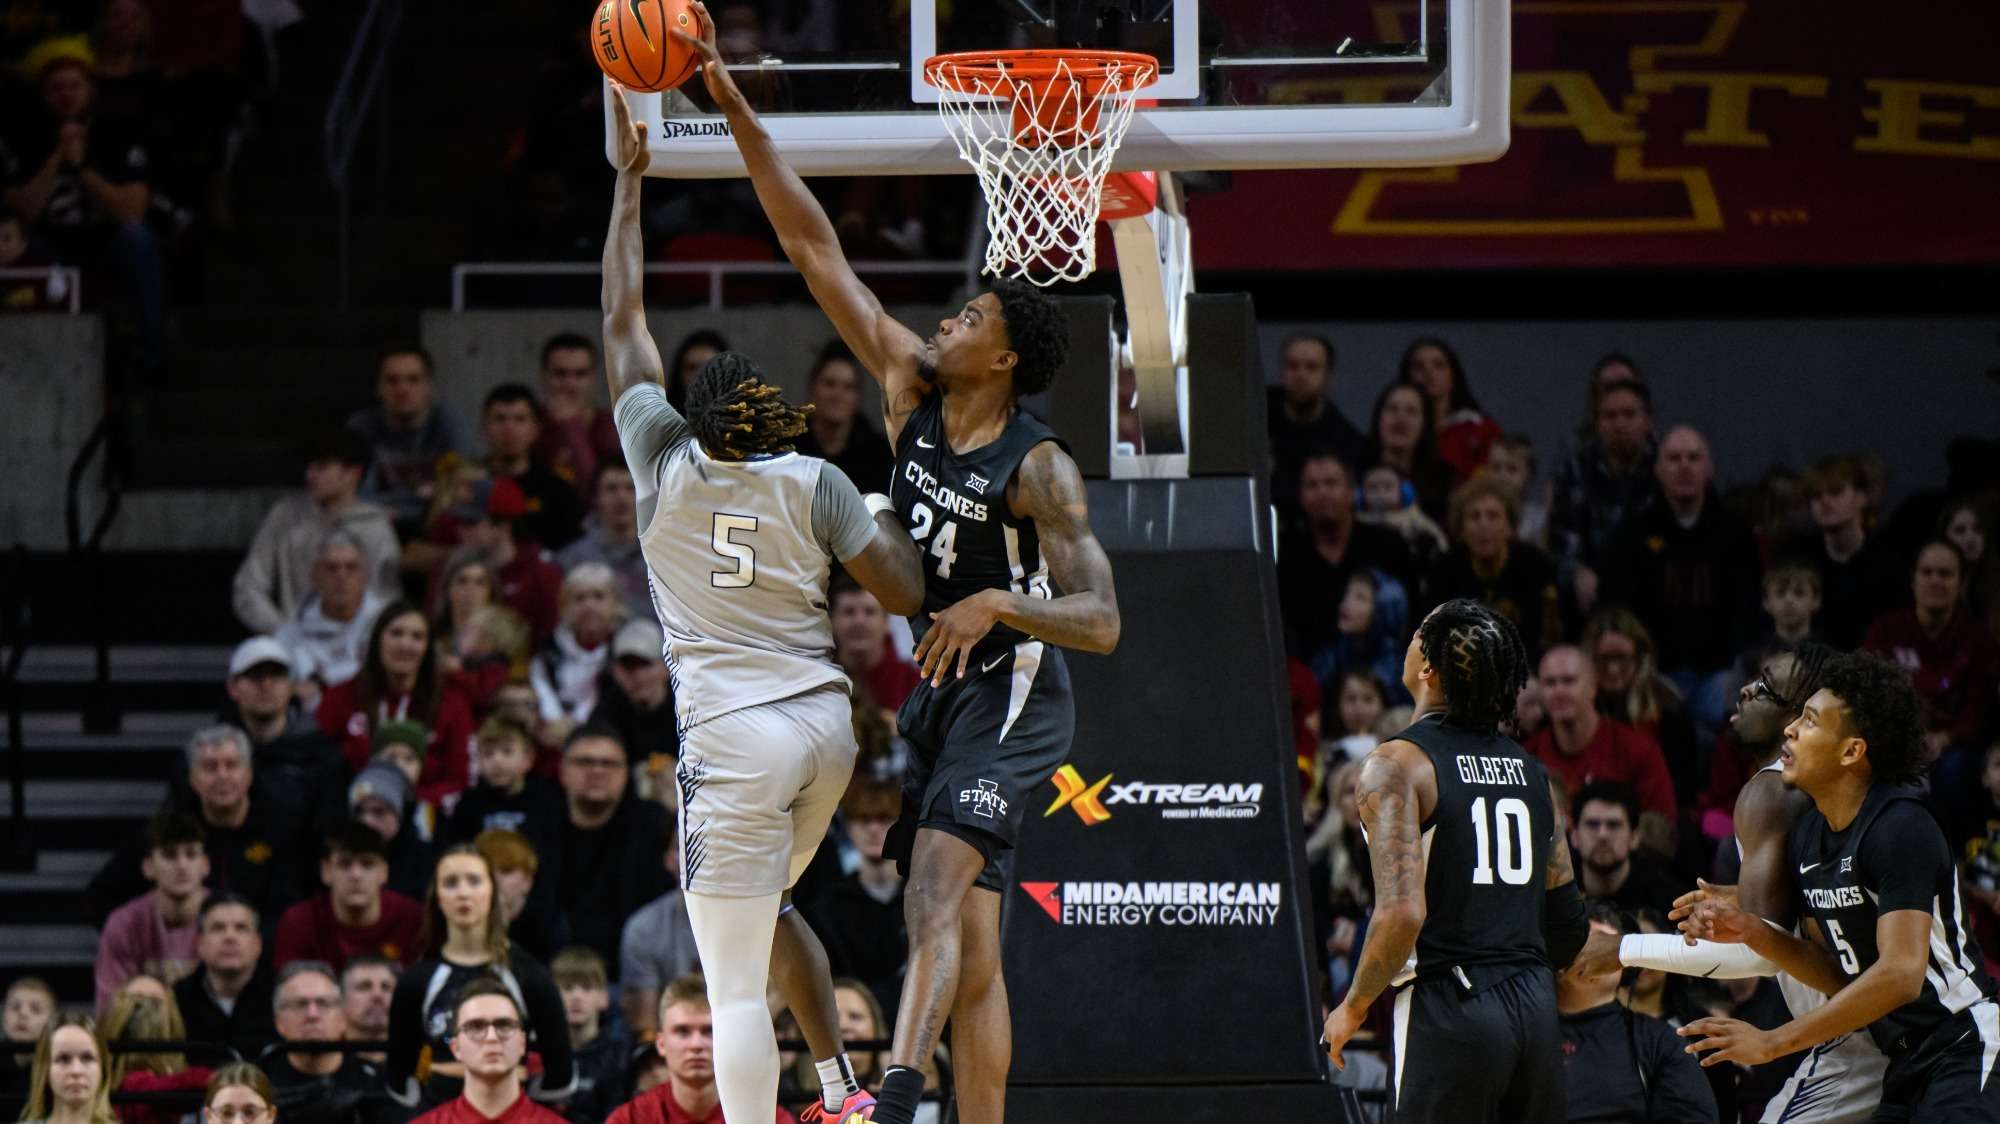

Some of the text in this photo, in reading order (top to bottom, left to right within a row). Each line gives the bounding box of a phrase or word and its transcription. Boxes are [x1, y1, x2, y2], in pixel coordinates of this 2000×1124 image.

[663, 121, 733, 139] SPALDIN
[905, 460, 988, 522] CYCLONES
[711, 511, 758, 589] 5
[909, 502, 958, 580] 24
[1456, 754, 1528, 787] GILBERT
[960, 789, 1008, 816] STATE
[1105, 781, 1264, 804] XTREAM
[1200, 804, 1254, 819] Mediacom
[1471, 796, 1533, 885] 10
[1063, 882, 1281, 906] MIDAMERICAN
[1063, 905, 1281, 926] ENERGY COMPANY
[1826, 919, 1860, 975] 5
